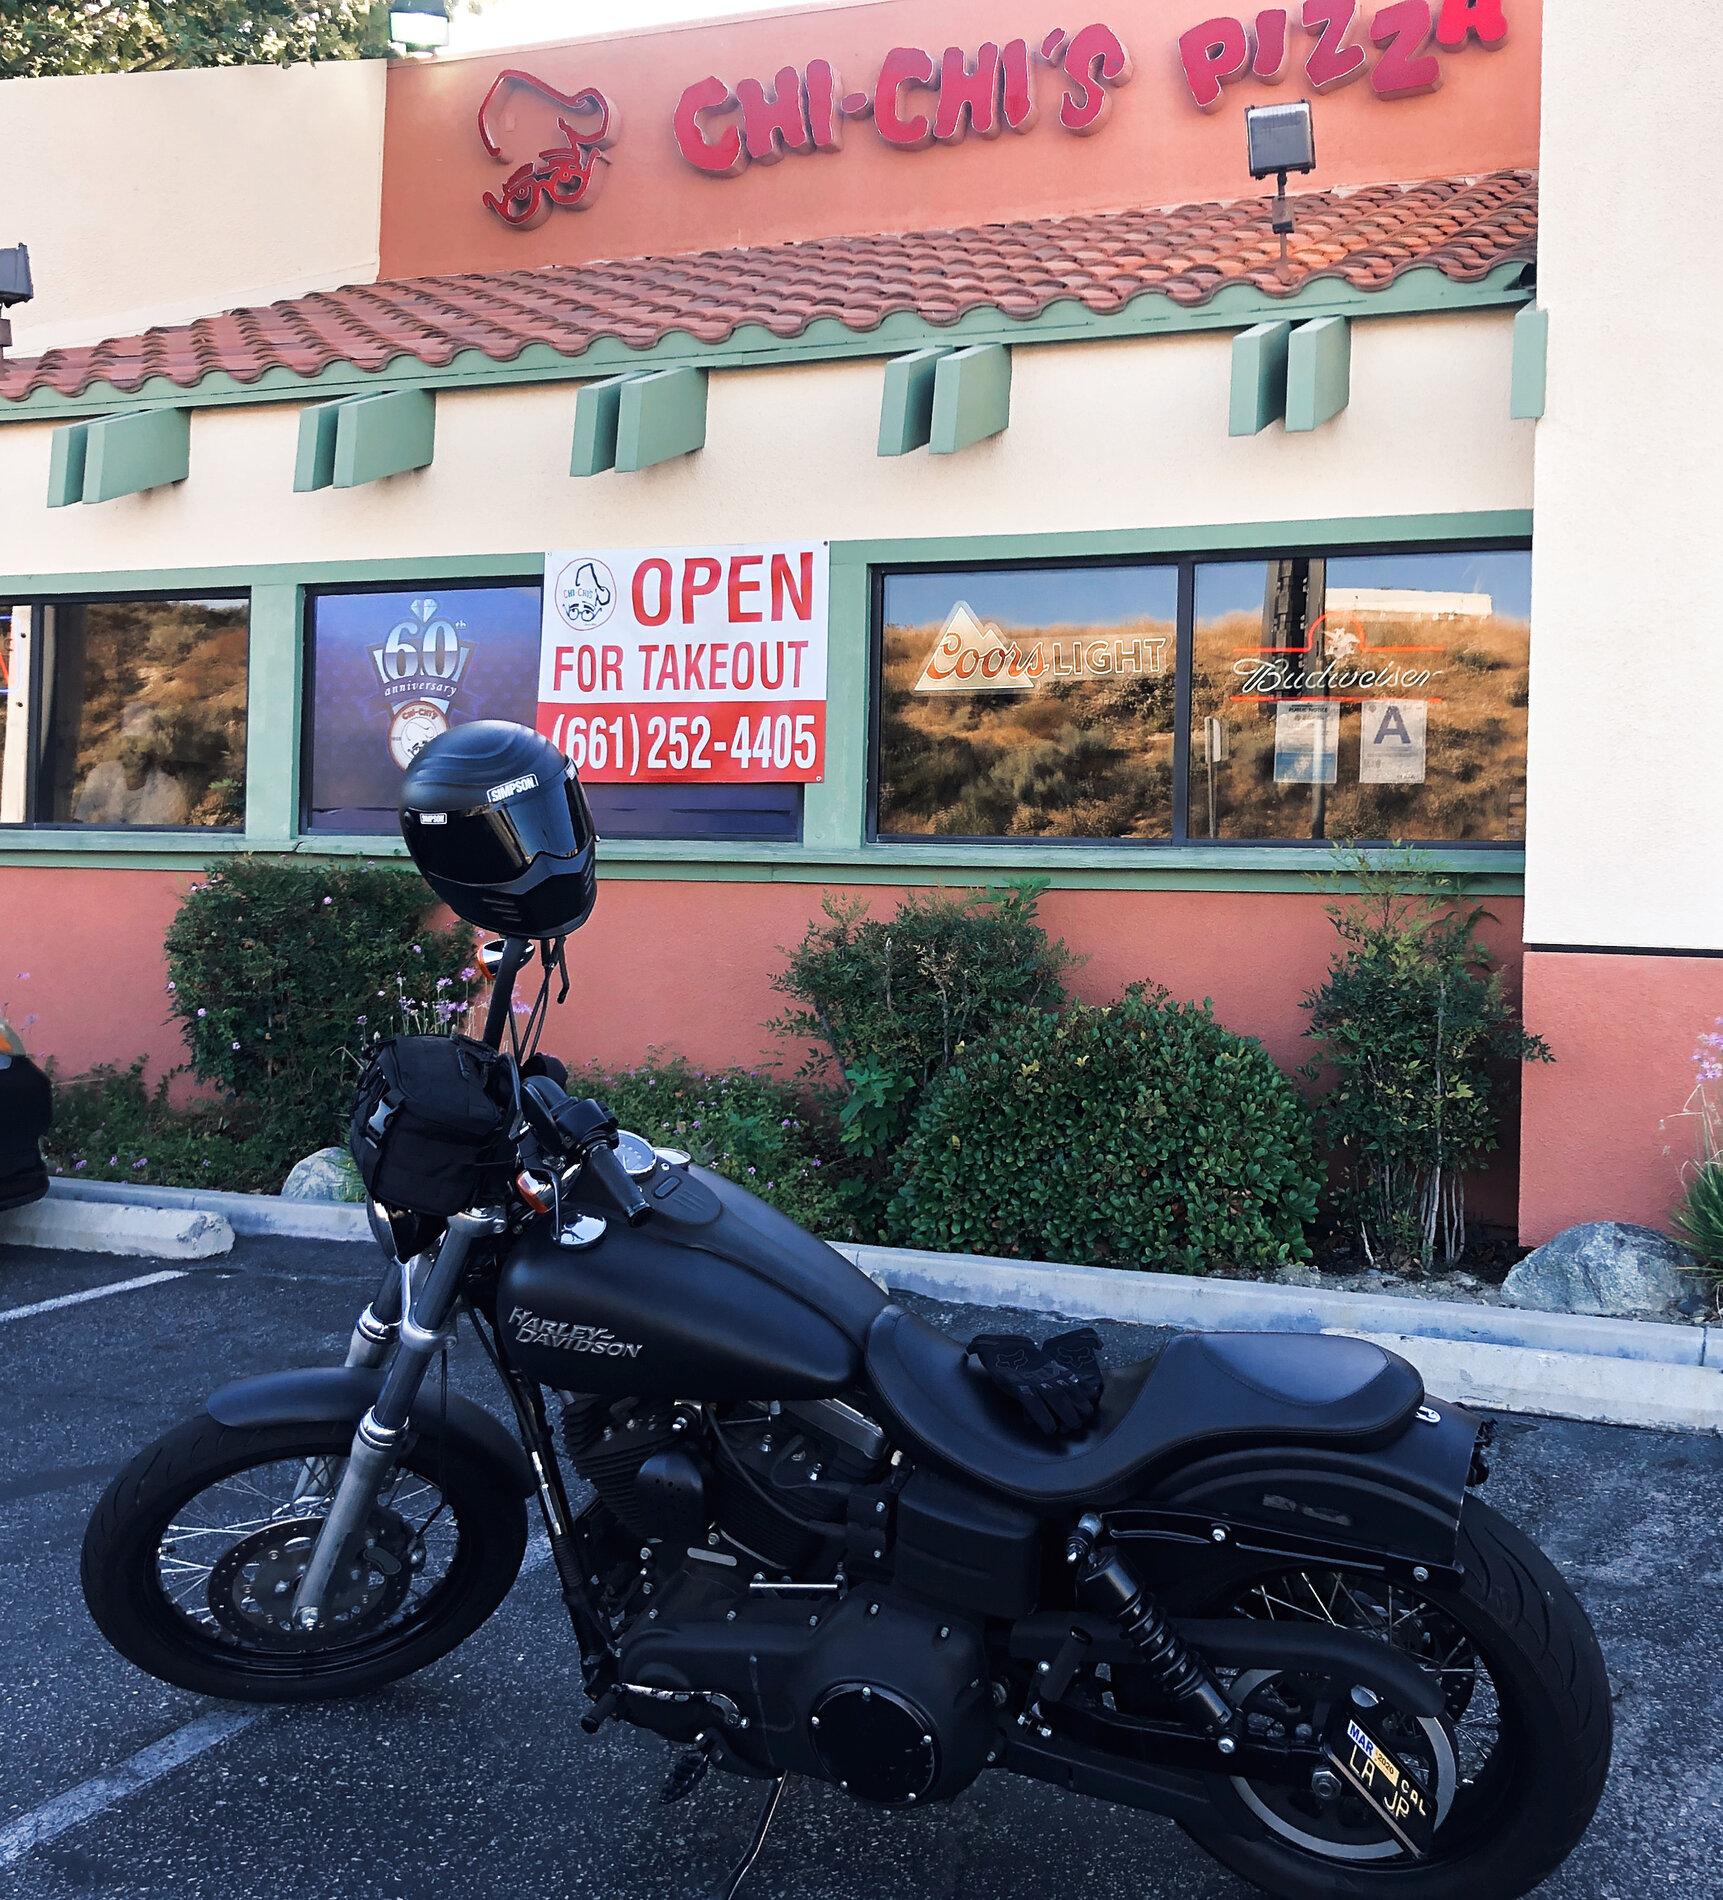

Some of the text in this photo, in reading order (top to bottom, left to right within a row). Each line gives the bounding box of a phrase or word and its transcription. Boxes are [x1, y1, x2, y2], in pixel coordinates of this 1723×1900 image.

[673, 0, 1508, 173] CHI-CHI'S PIZZA
[631, 552, 814, 627] OPEN
[553, 640, 809, 693] FOR TAKEOUT
[926, 632, 1167, 680] Coors LIGHT
[1233, 658, 1445, 694] Budweiser
[384, 680, 458, 698] anniversary
[551, 713, 817, 776] (661) 252-4405
[1373, 705, 1412, 745] A
[490, 776, 537, 802] SIMPSON
[515, 1327, 643, 1358] DAVIDSON
[1349, 1723, 1395, 1776] MAR 2020
[1401, 1779, 1427, 1816] CAL
